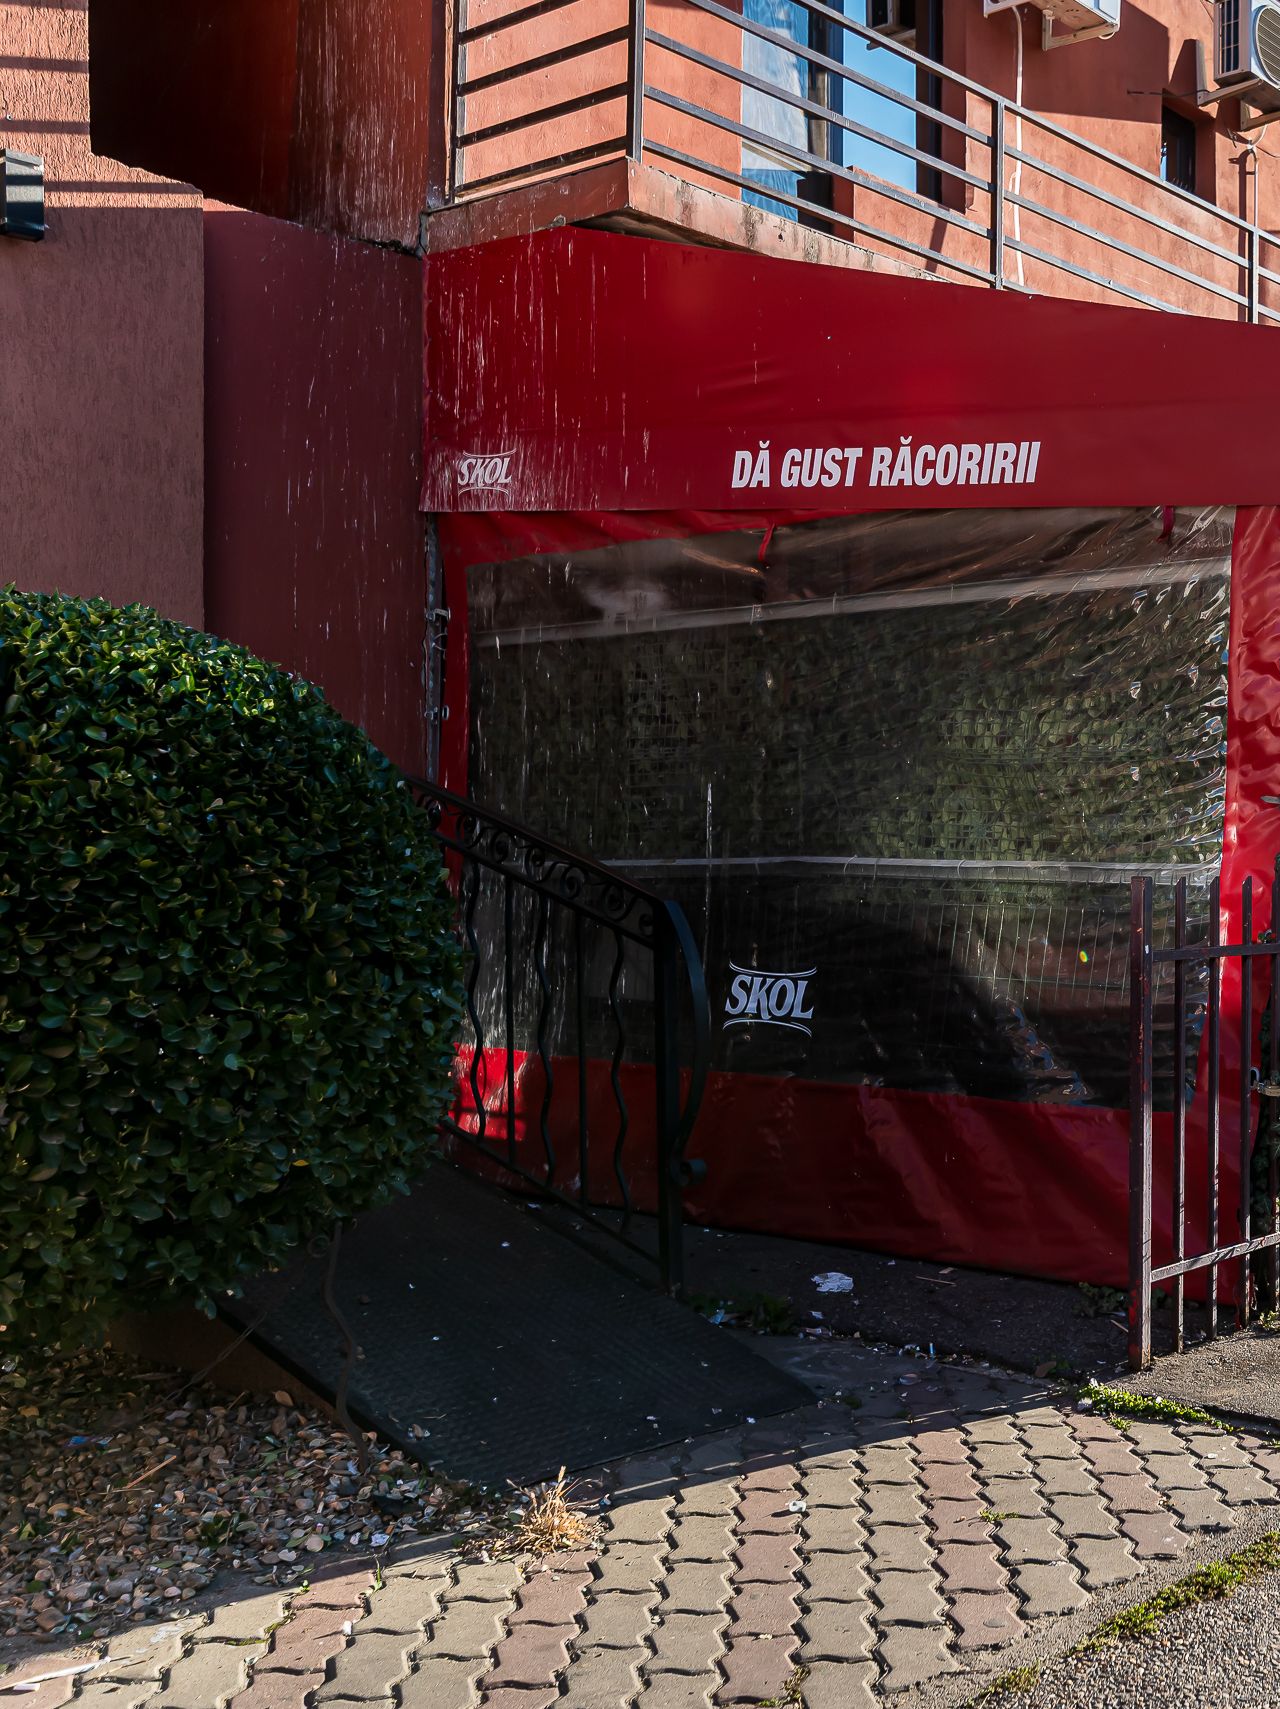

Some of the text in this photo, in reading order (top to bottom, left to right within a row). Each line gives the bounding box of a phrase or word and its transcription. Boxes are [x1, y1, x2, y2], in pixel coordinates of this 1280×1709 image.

[457, 457, 512, 487] SKOL
[731, 435, 1041, 488] DĂ GUST RĂCORIRII
[724, 974, 815, 1020] SKOL
